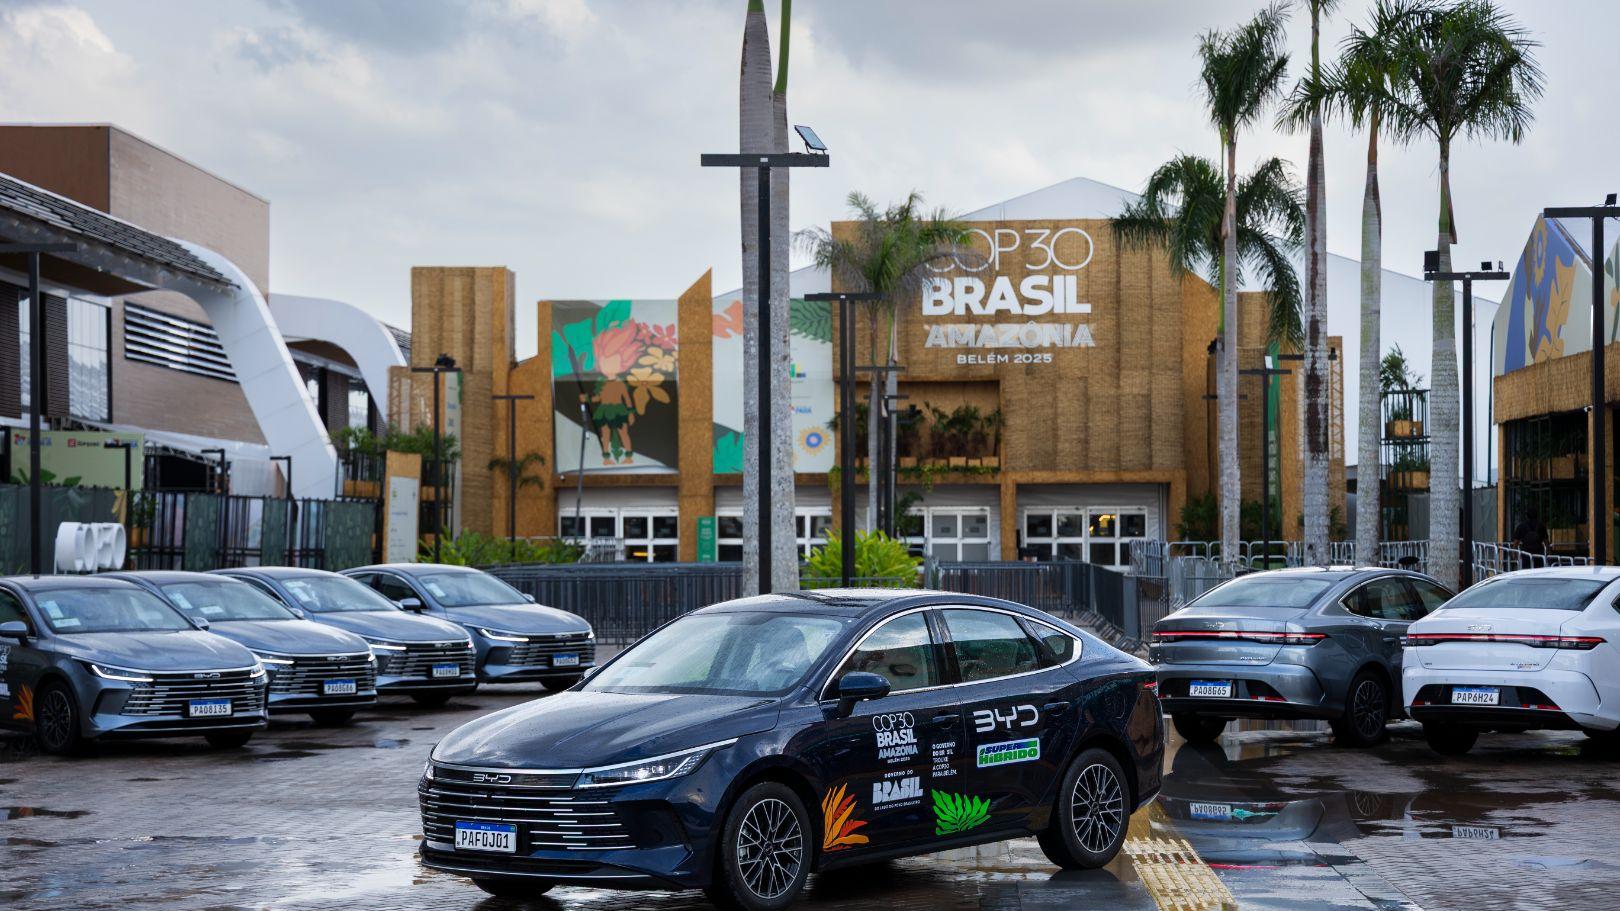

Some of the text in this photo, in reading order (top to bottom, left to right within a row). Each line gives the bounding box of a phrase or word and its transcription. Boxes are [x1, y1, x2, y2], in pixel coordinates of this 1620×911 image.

[922, 275, 1092, 316] BRASIL
[923, 320, 1096, 348] AMAZÔNIA
[956, 351, 1053, 364] BELÉM 2025
[1456, 692, 1494, 703] PAP6H24
[972, 704, 1039, 733] BYD
[876, 728, 917, 748] BRASIL
[984, 742, 1021, 755] SUPER
[473, 773, 512, 784] BYD
[872, 776, 924, 804] BRASIL
